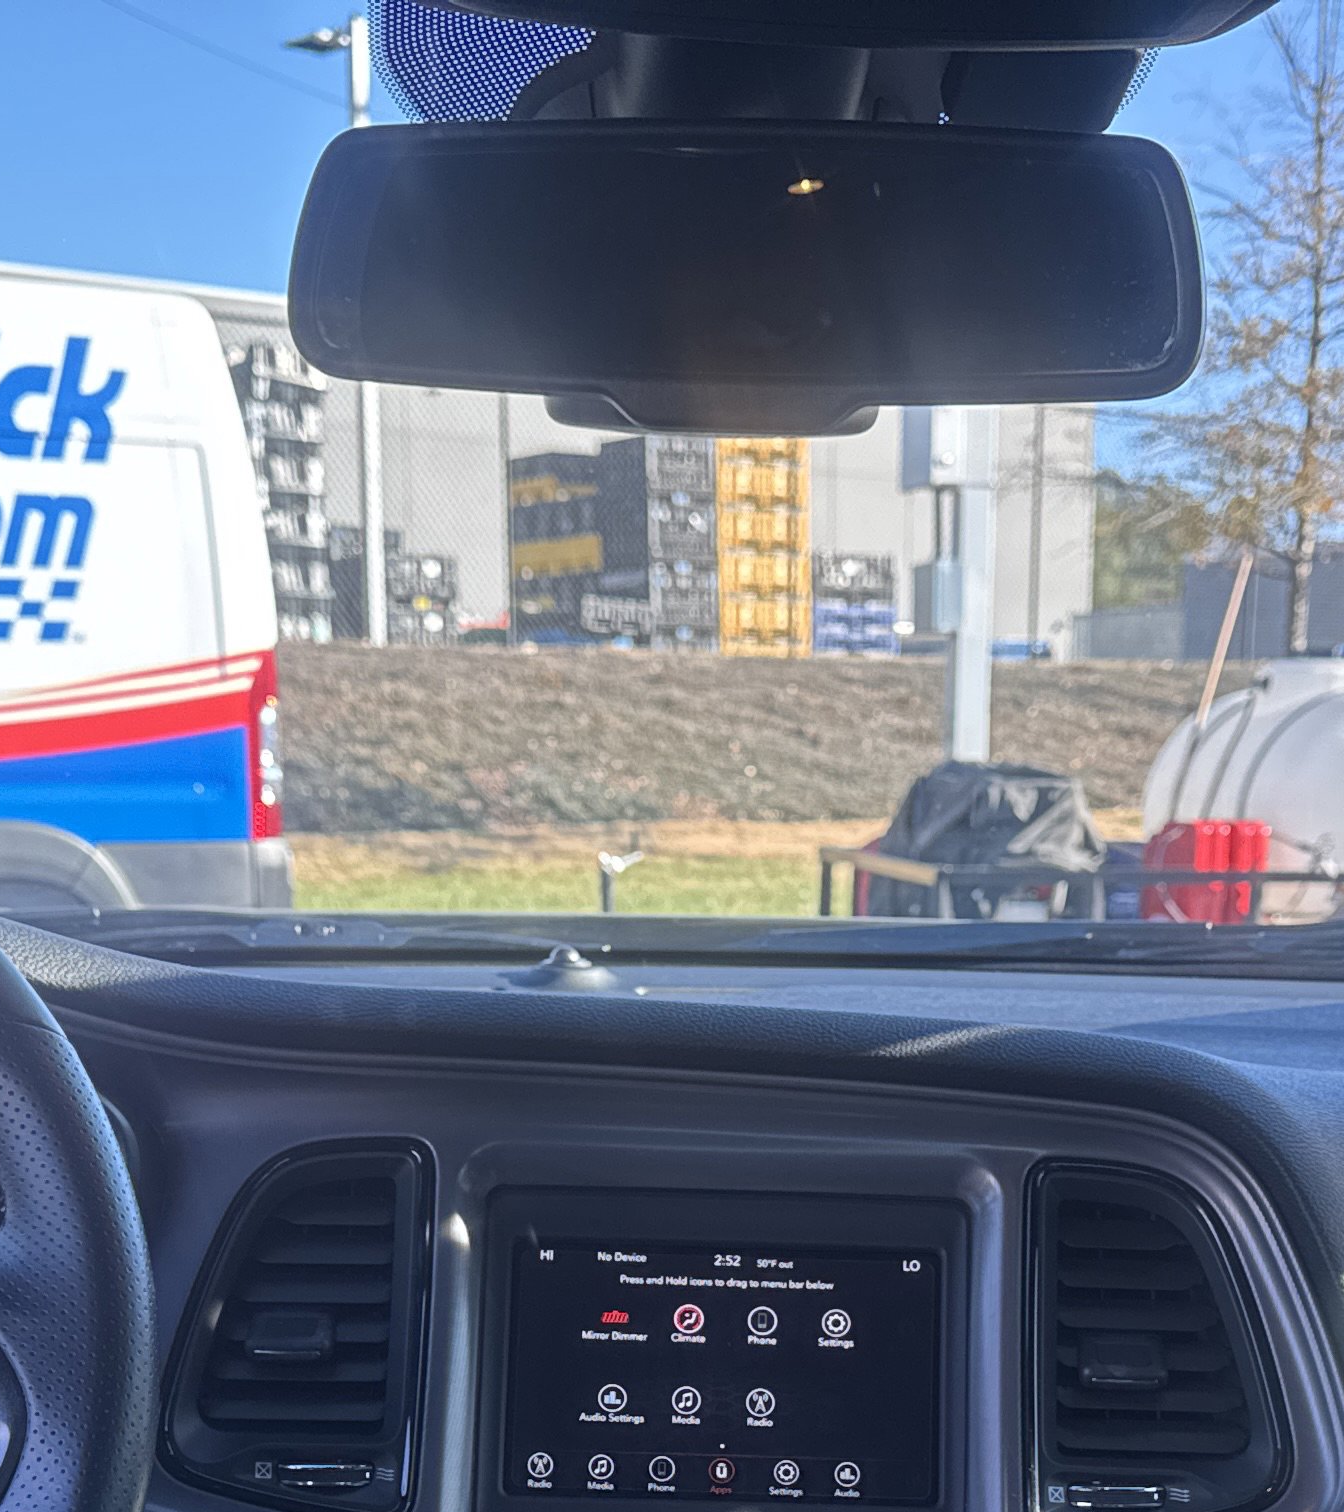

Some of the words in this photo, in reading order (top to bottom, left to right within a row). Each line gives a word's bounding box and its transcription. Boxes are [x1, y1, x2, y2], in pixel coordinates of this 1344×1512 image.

[539, 1250, 554, 1261] HI
[597, 1252, 612, 1262] No
[613, 1252, 647, 1263] Device
[713, 1254, 742, 1266] 2:52
[778, 1260, 794, 1269] out
[902, 1260, 921, 1272] LO
[619, 1274, 643, 1285] Press
[645, 1276, 663, 1285] and
[665, 1276, 687, 1286] Hold
[689, 1277, 713, 1287] icons
[714, 1278, 725, 1287] to
[726, 1278, 748, 1290] drag
[749, 1279, 759, 1288] to
[760, 1281, 786, 1289] menu
[787, 1280, 804, 1289] bar
[806, 1280, 834, 1290] below
[581, 1330, 609, 1342] Mirror
[611, 1331, 648, 1343] Dimmer
[670, 1333, 706, 1344] Climate
[747, 1335, 777, 1346] Phone
[817, 1337, 854, 1349] Settings
[579, 1413, 608, 1424] Audio
[609, 1413, 645, 1425] Settings
[671, 1415, 701, 1426] Media
[746, 1417, 774, 1428] Radio
[526, 1479, 552, 1489] Radio
[587, 1480, 615, 1492] Media
[647, 1483, 676, 1493] Phone
[709, 1485, 732, 1496] Apps
[768, 1486, 804, 1498] Settings
[834, 1488, 860, 1499] Audio
